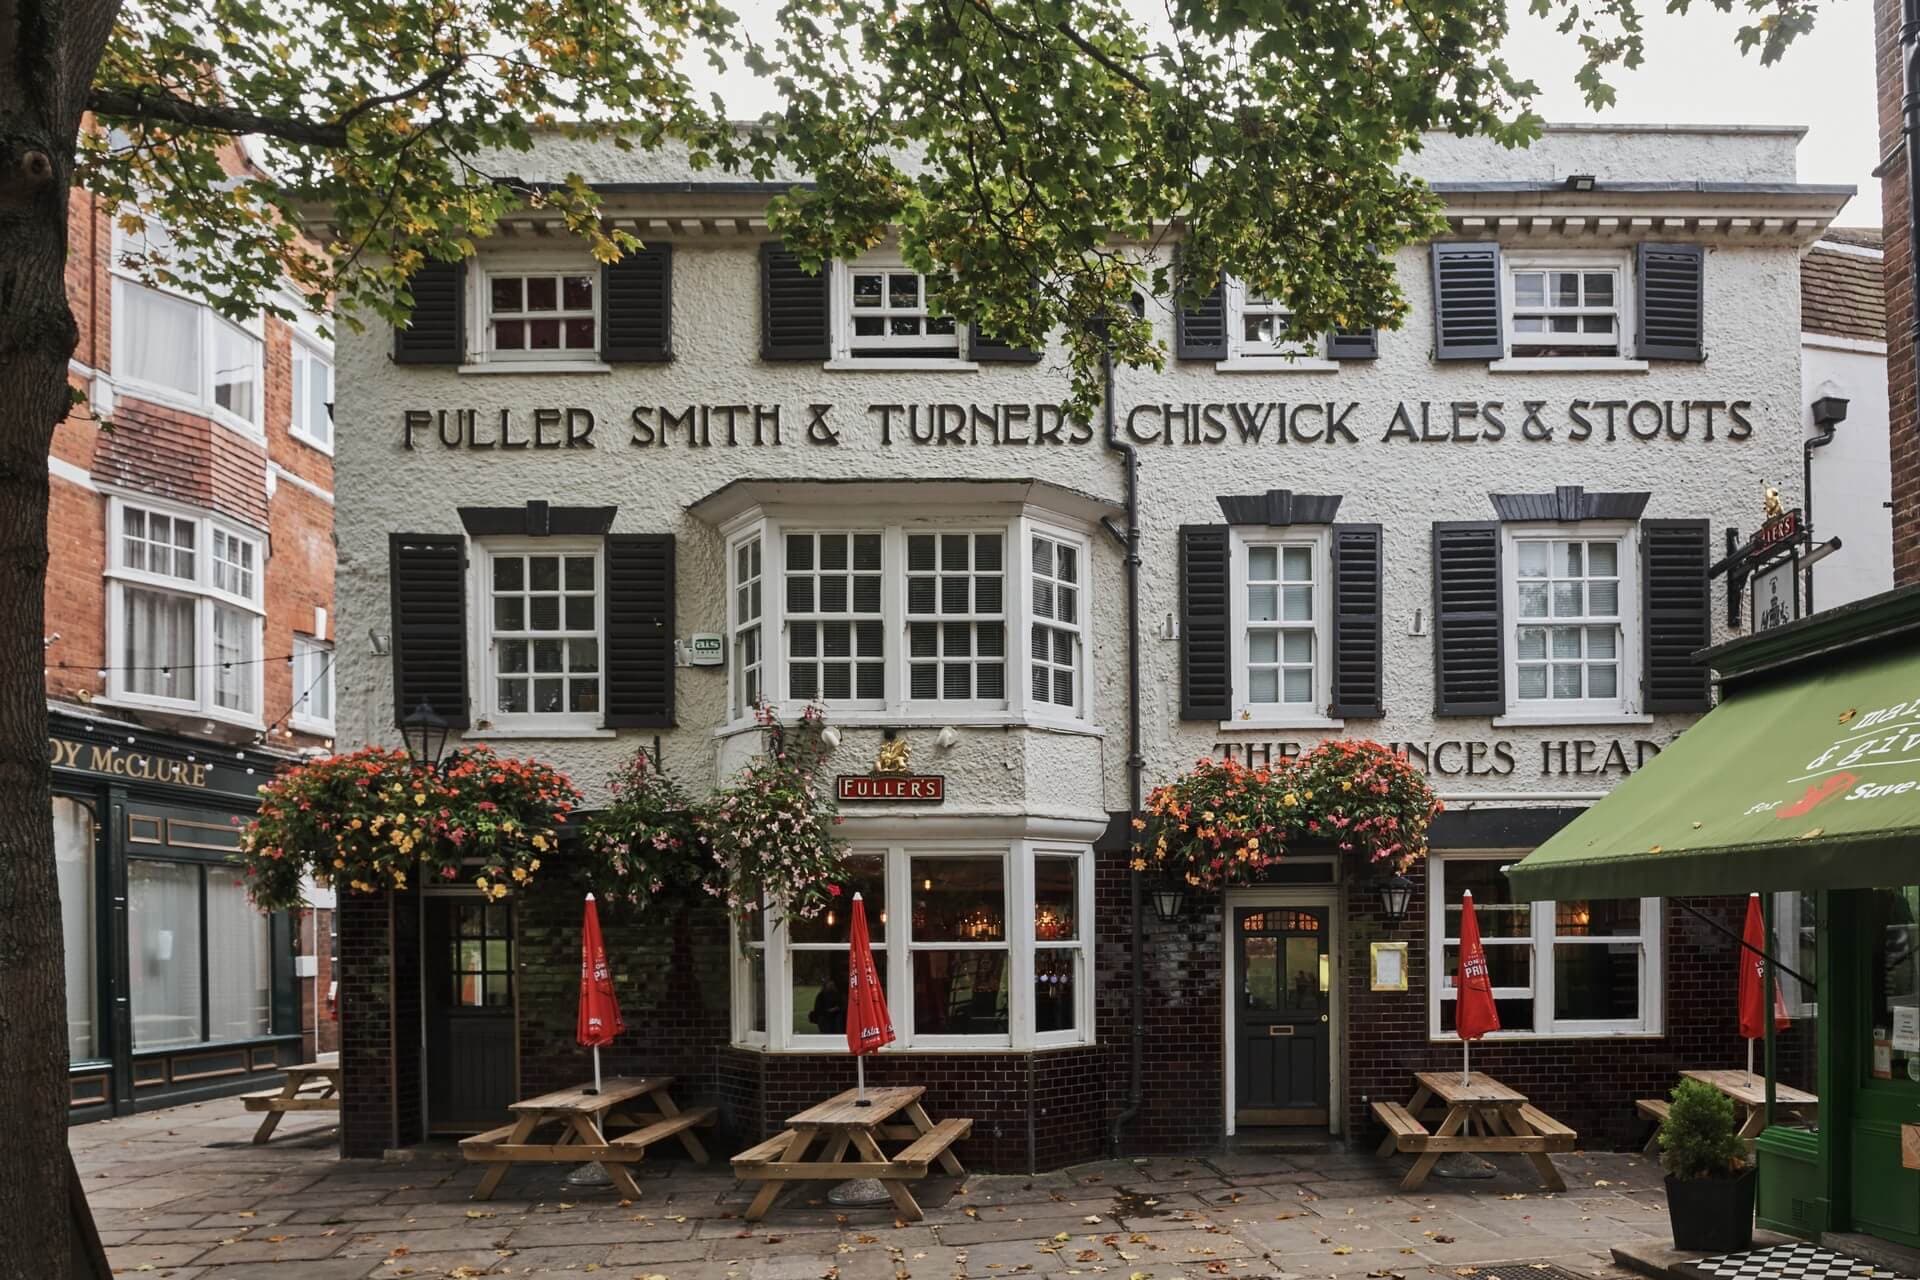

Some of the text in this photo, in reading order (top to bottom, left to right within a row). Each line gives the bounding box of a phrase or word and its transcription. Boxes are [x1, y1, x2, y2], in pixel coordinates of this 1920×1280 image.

[403, 402, 1094, 450] FULLER SMITH & TURNERS
[1125, 400, 1754, 447] CHISWICK ALES & STOUTS
[90, 746, 206, 787] McCLURE
[1389, 740, 1515, 776] NCES
[844, 779, 936, 797] FULLER'S
[1845, 781, 1917, 800] Save
